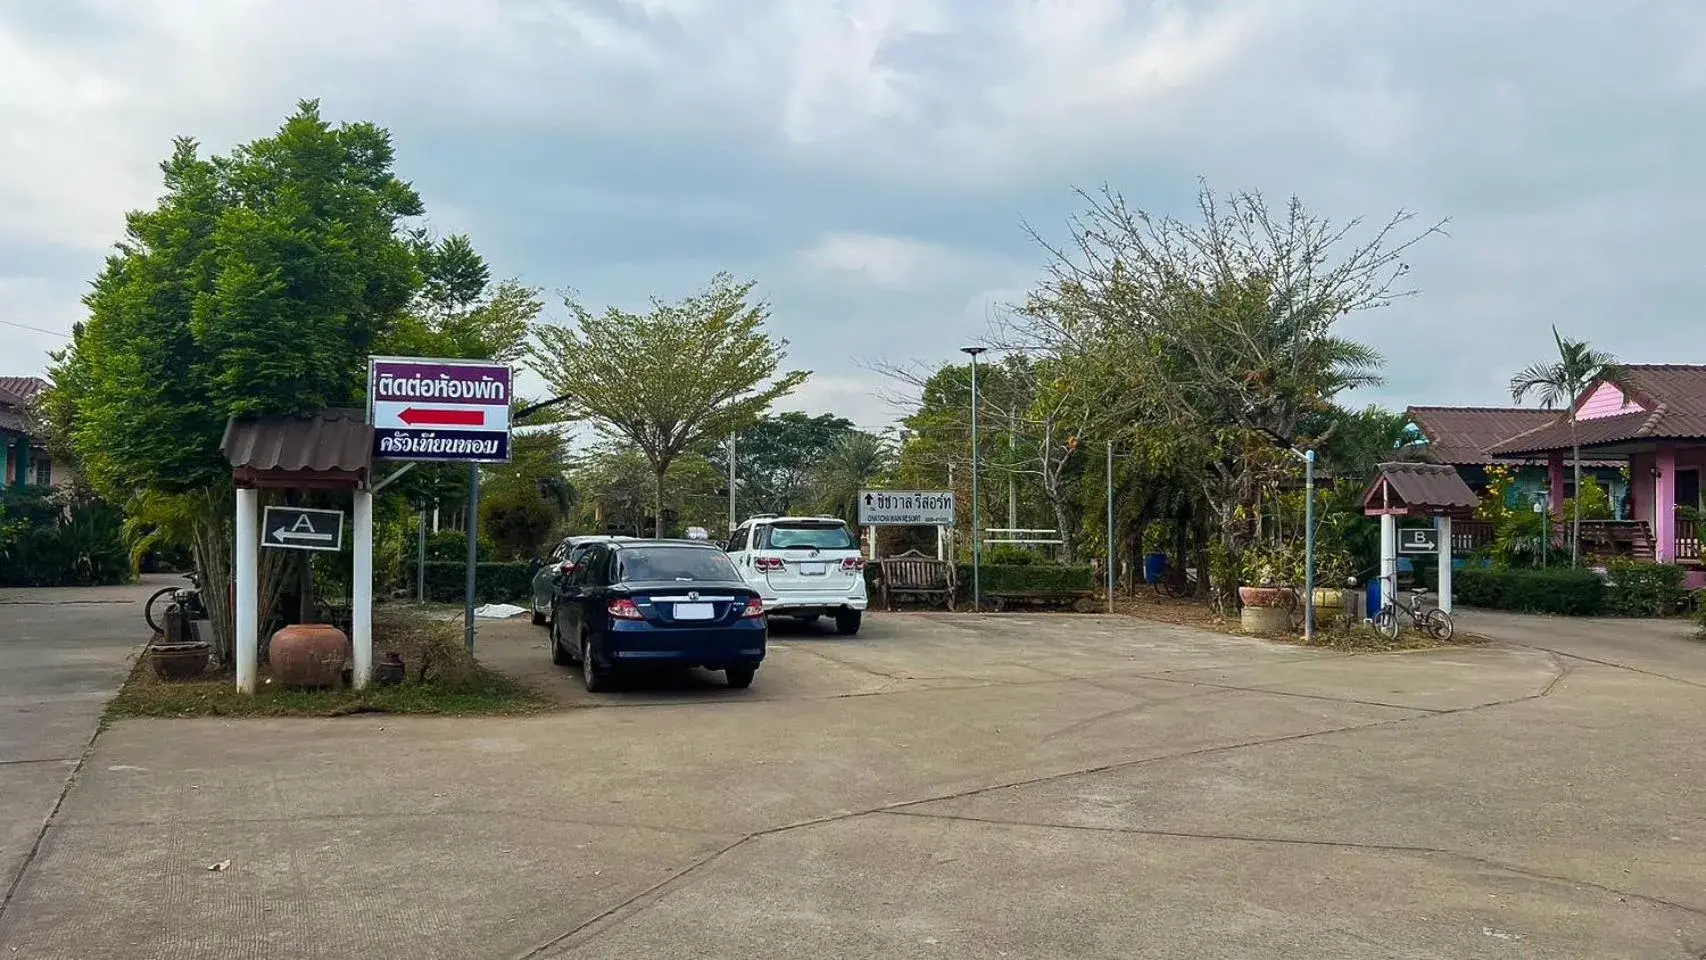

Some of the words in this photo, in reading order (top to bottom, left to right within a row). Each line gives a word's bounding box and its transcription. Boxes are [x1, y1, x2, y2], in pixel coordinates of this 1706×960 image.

[379, 373, 504, 399] ติดต่อห้องพัก
[380, 431, 498, 454] ครัวเทียนหอม
[914, 492, 952, 509] รีสอร์ท
[291, 513, 315, 533] A
[1414, 531, 1426, 543] B
